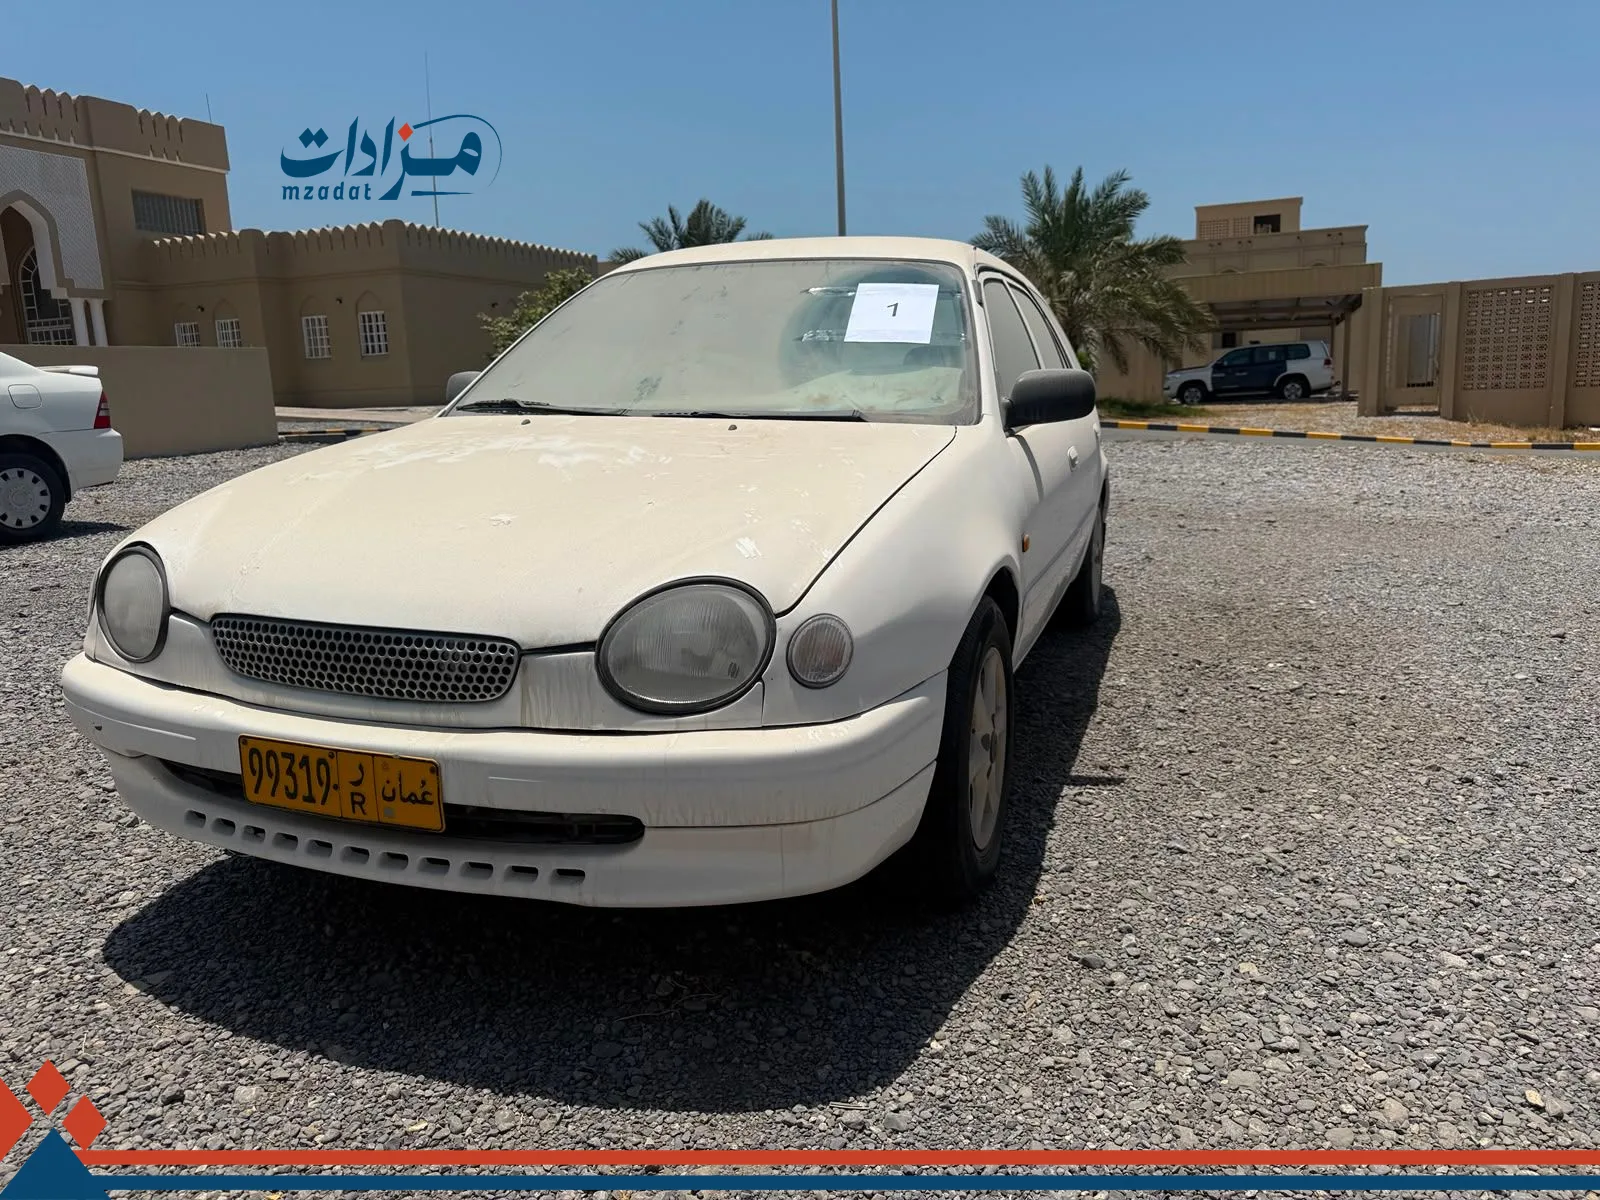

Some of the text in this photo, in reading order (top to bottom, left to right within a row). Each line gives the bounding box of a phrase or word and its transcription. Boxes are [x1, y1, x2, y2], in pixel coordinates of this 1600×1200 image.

[887, 302, 899, 317] 1
[248, 747, 331, 806] 99319
[351, 791, 366, 815] R
